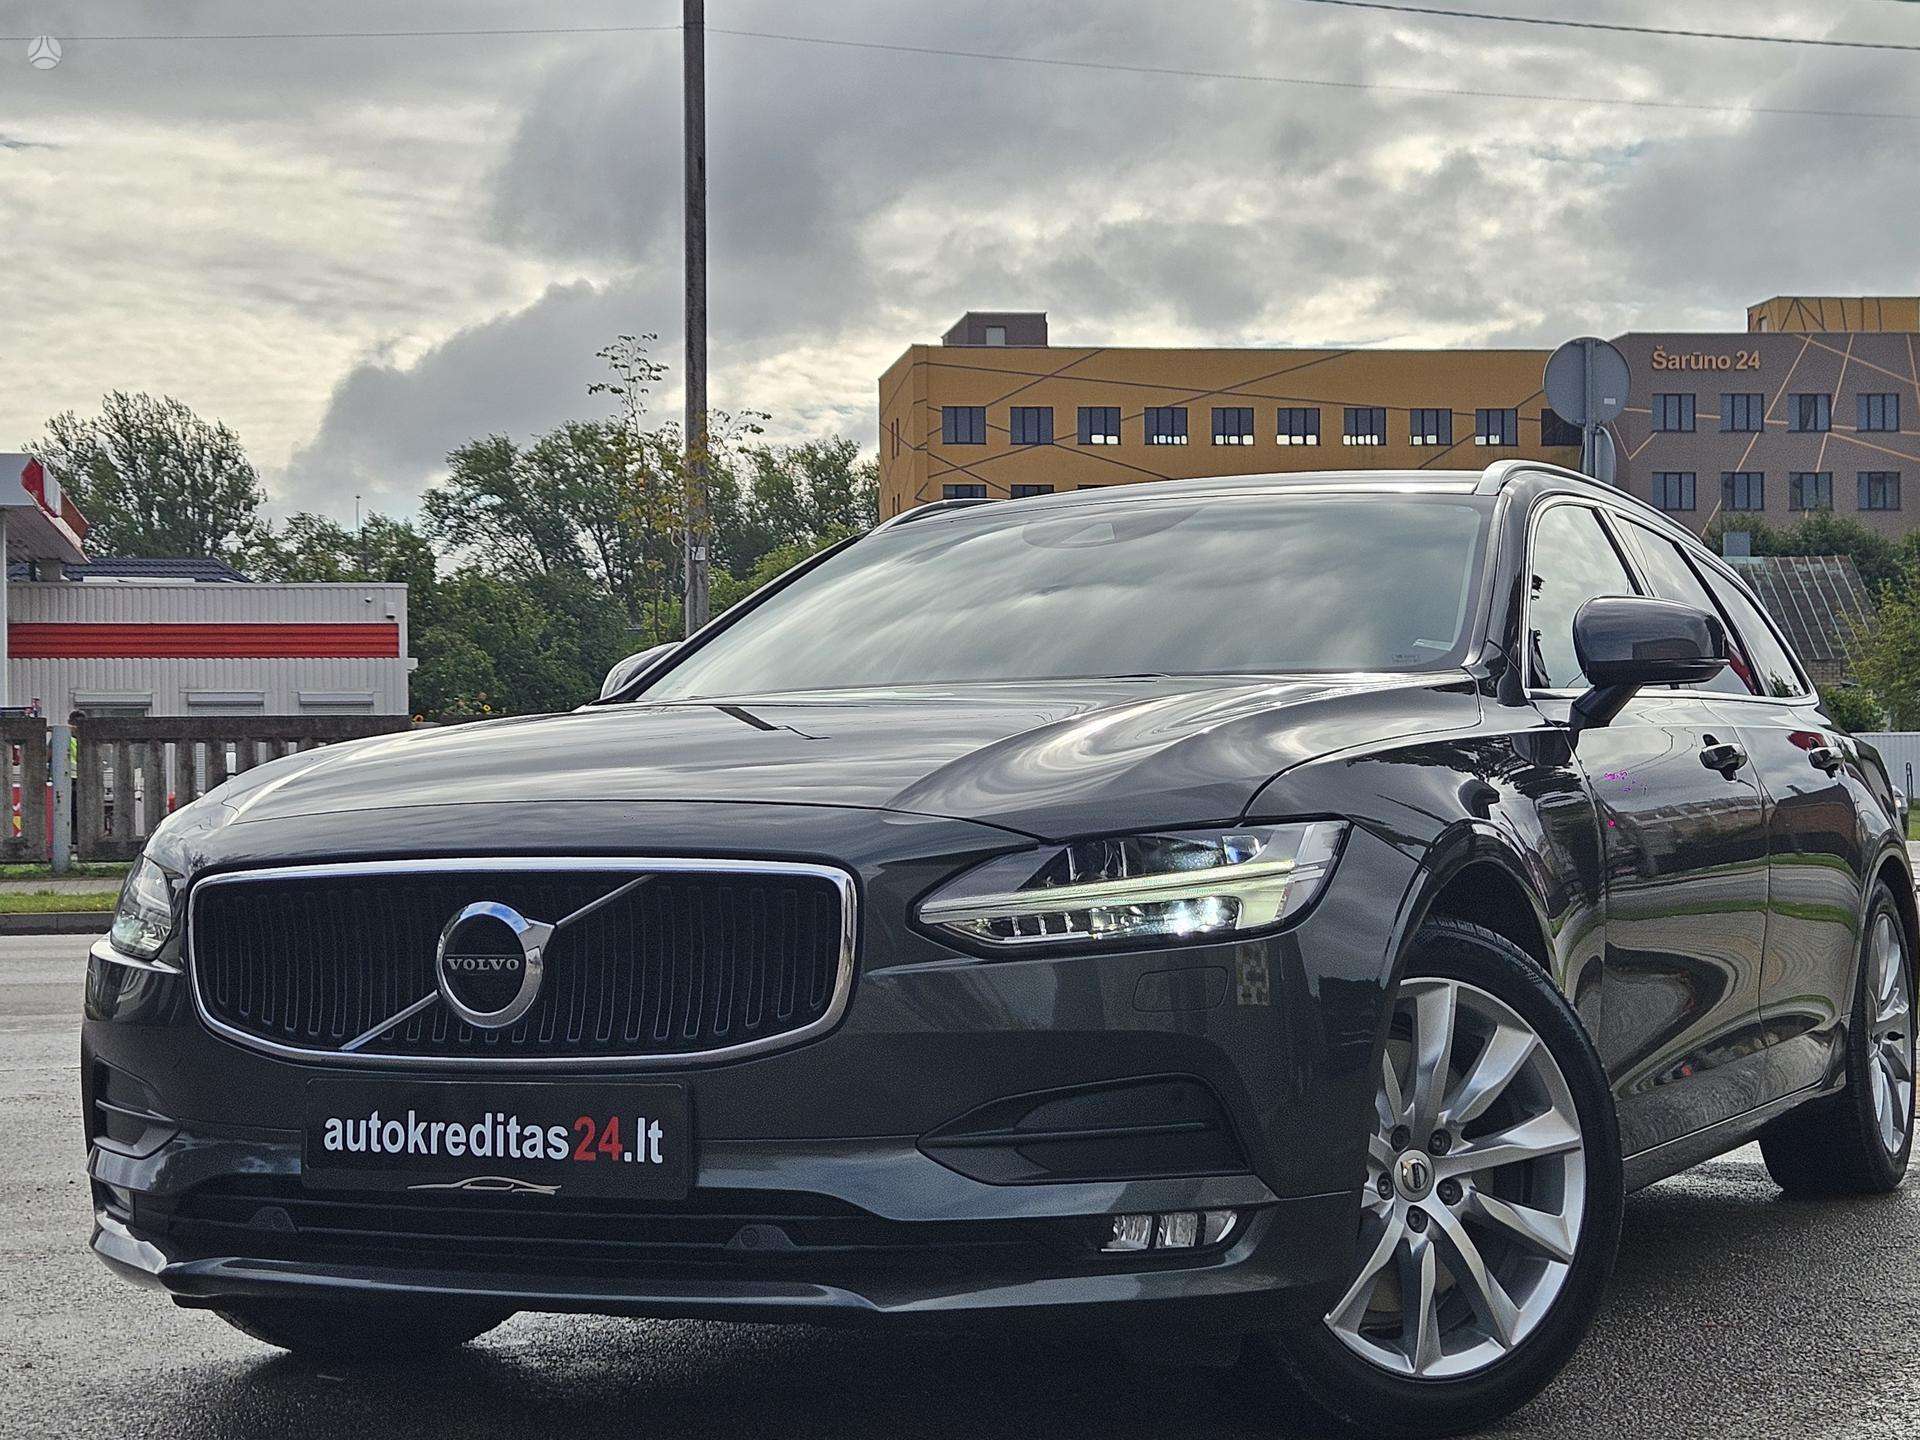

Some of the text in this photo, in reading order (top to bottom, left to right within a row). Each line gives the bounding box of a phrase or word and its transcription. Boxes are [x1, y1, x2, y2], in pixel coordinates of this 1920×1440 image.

[1652, 345, 1761, 370] Šarūno 24
[447, 958, 519, 971] VOLVO
[323, 1110, 664, 1164] autokreditas24.lt
